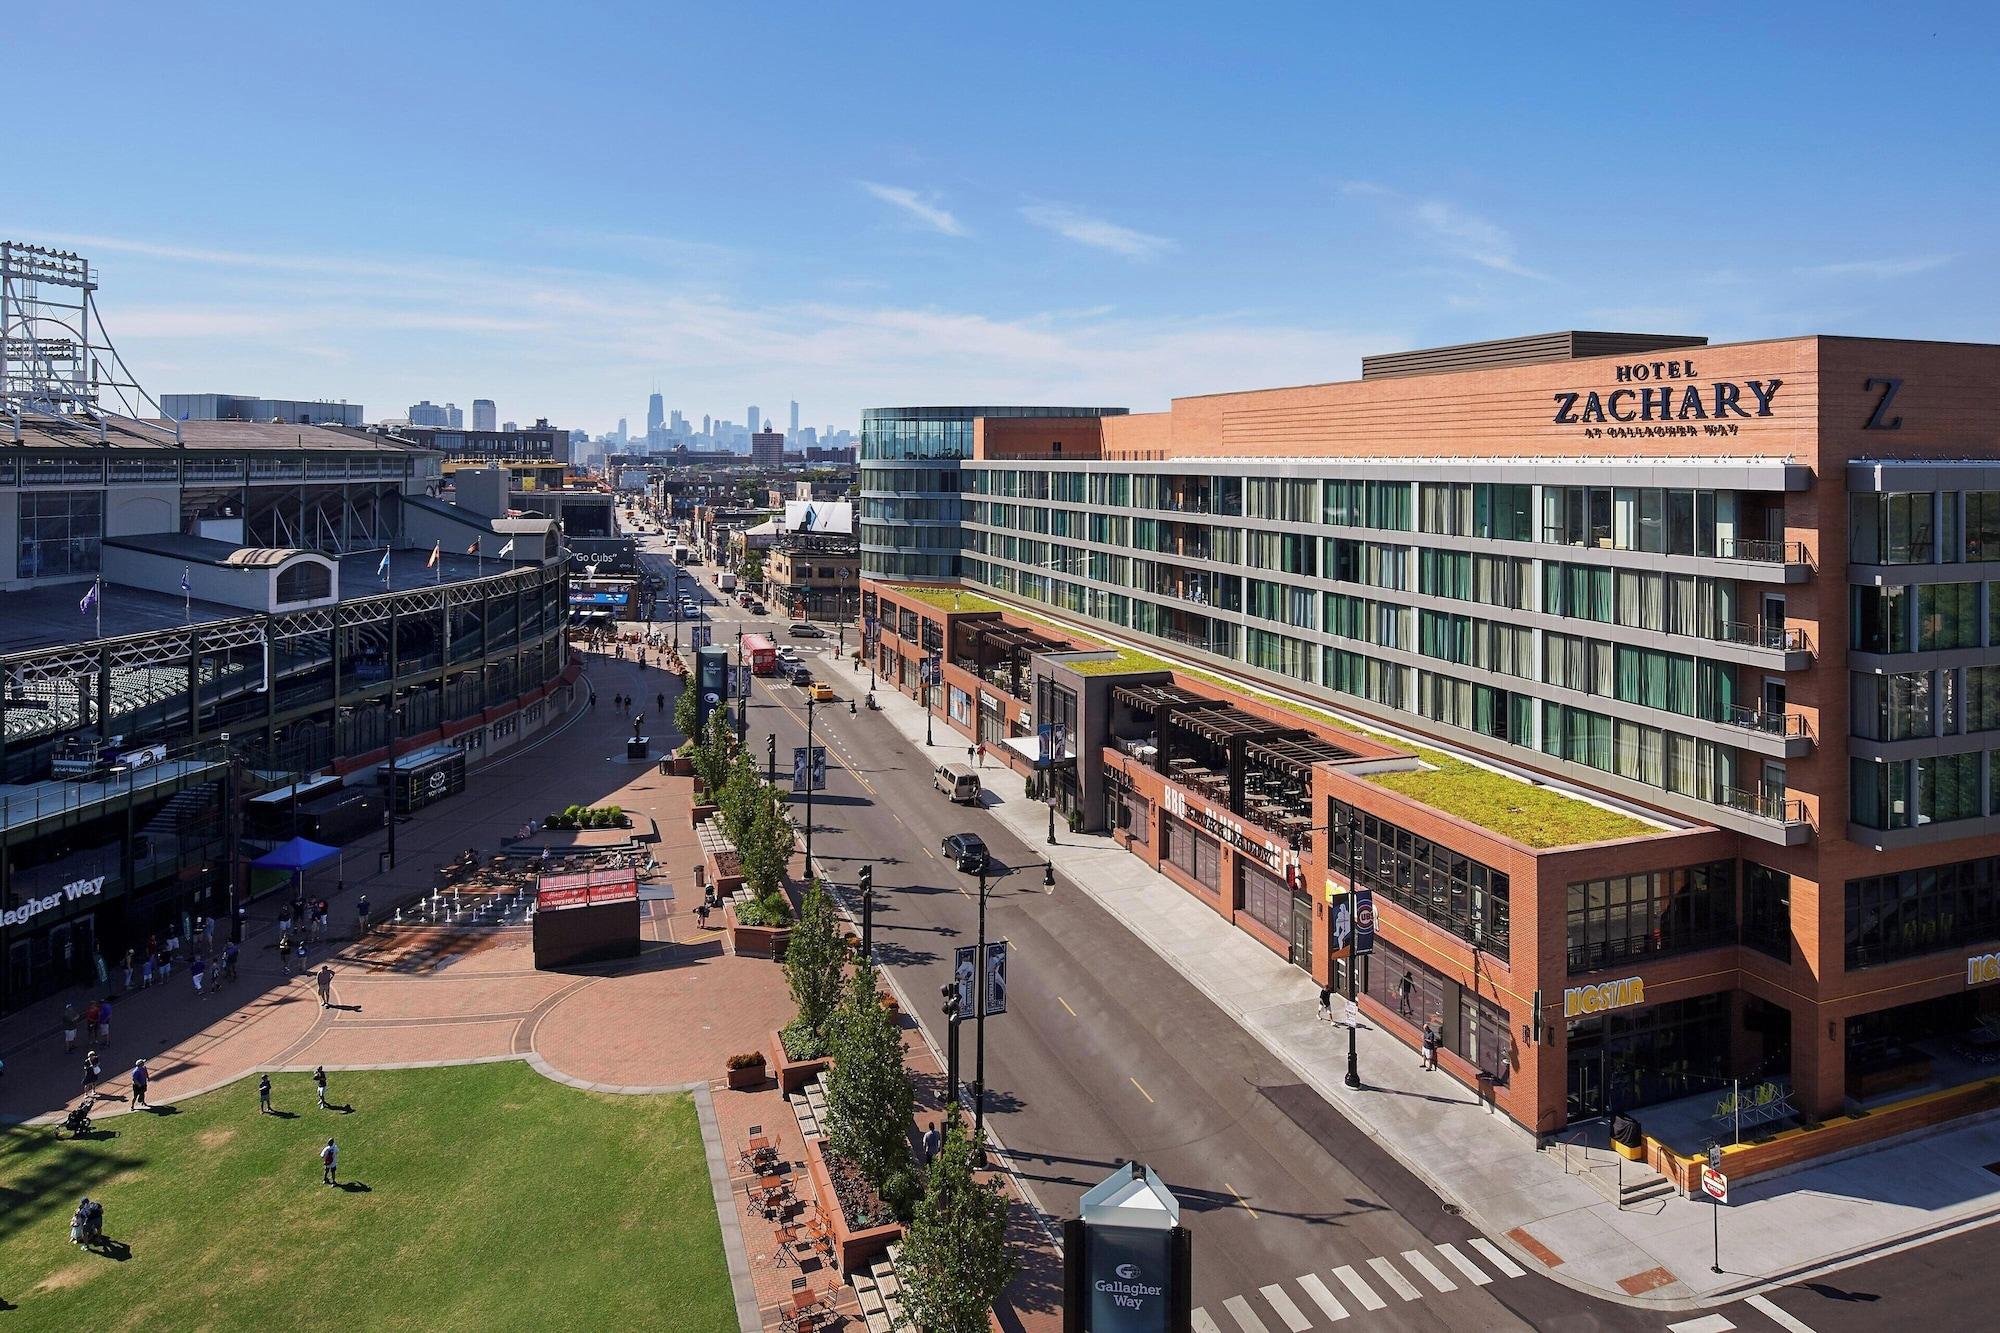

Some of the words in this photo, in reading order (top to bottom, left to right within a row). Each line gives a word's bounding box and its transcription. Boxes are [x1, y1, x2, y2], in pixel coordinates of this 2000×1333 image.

[1615, 359, 1698, 383] HOTEL
[1553, 379, 1784, 424] ZACHARY
[1863, 378, 1904, 430] Z
[1584, 427, 1602, 439] AT
[1606, 424, 1698, 439] GALLAGHER
[1703, 424, 1739, 437] WAY
[1164, 784, 1186, 820] BBQ
[62, 875, 106, 901] Way
[1095, 1280, 1161, 1296] Gallagher
[1113, 1294, 1143, 1310] Way
